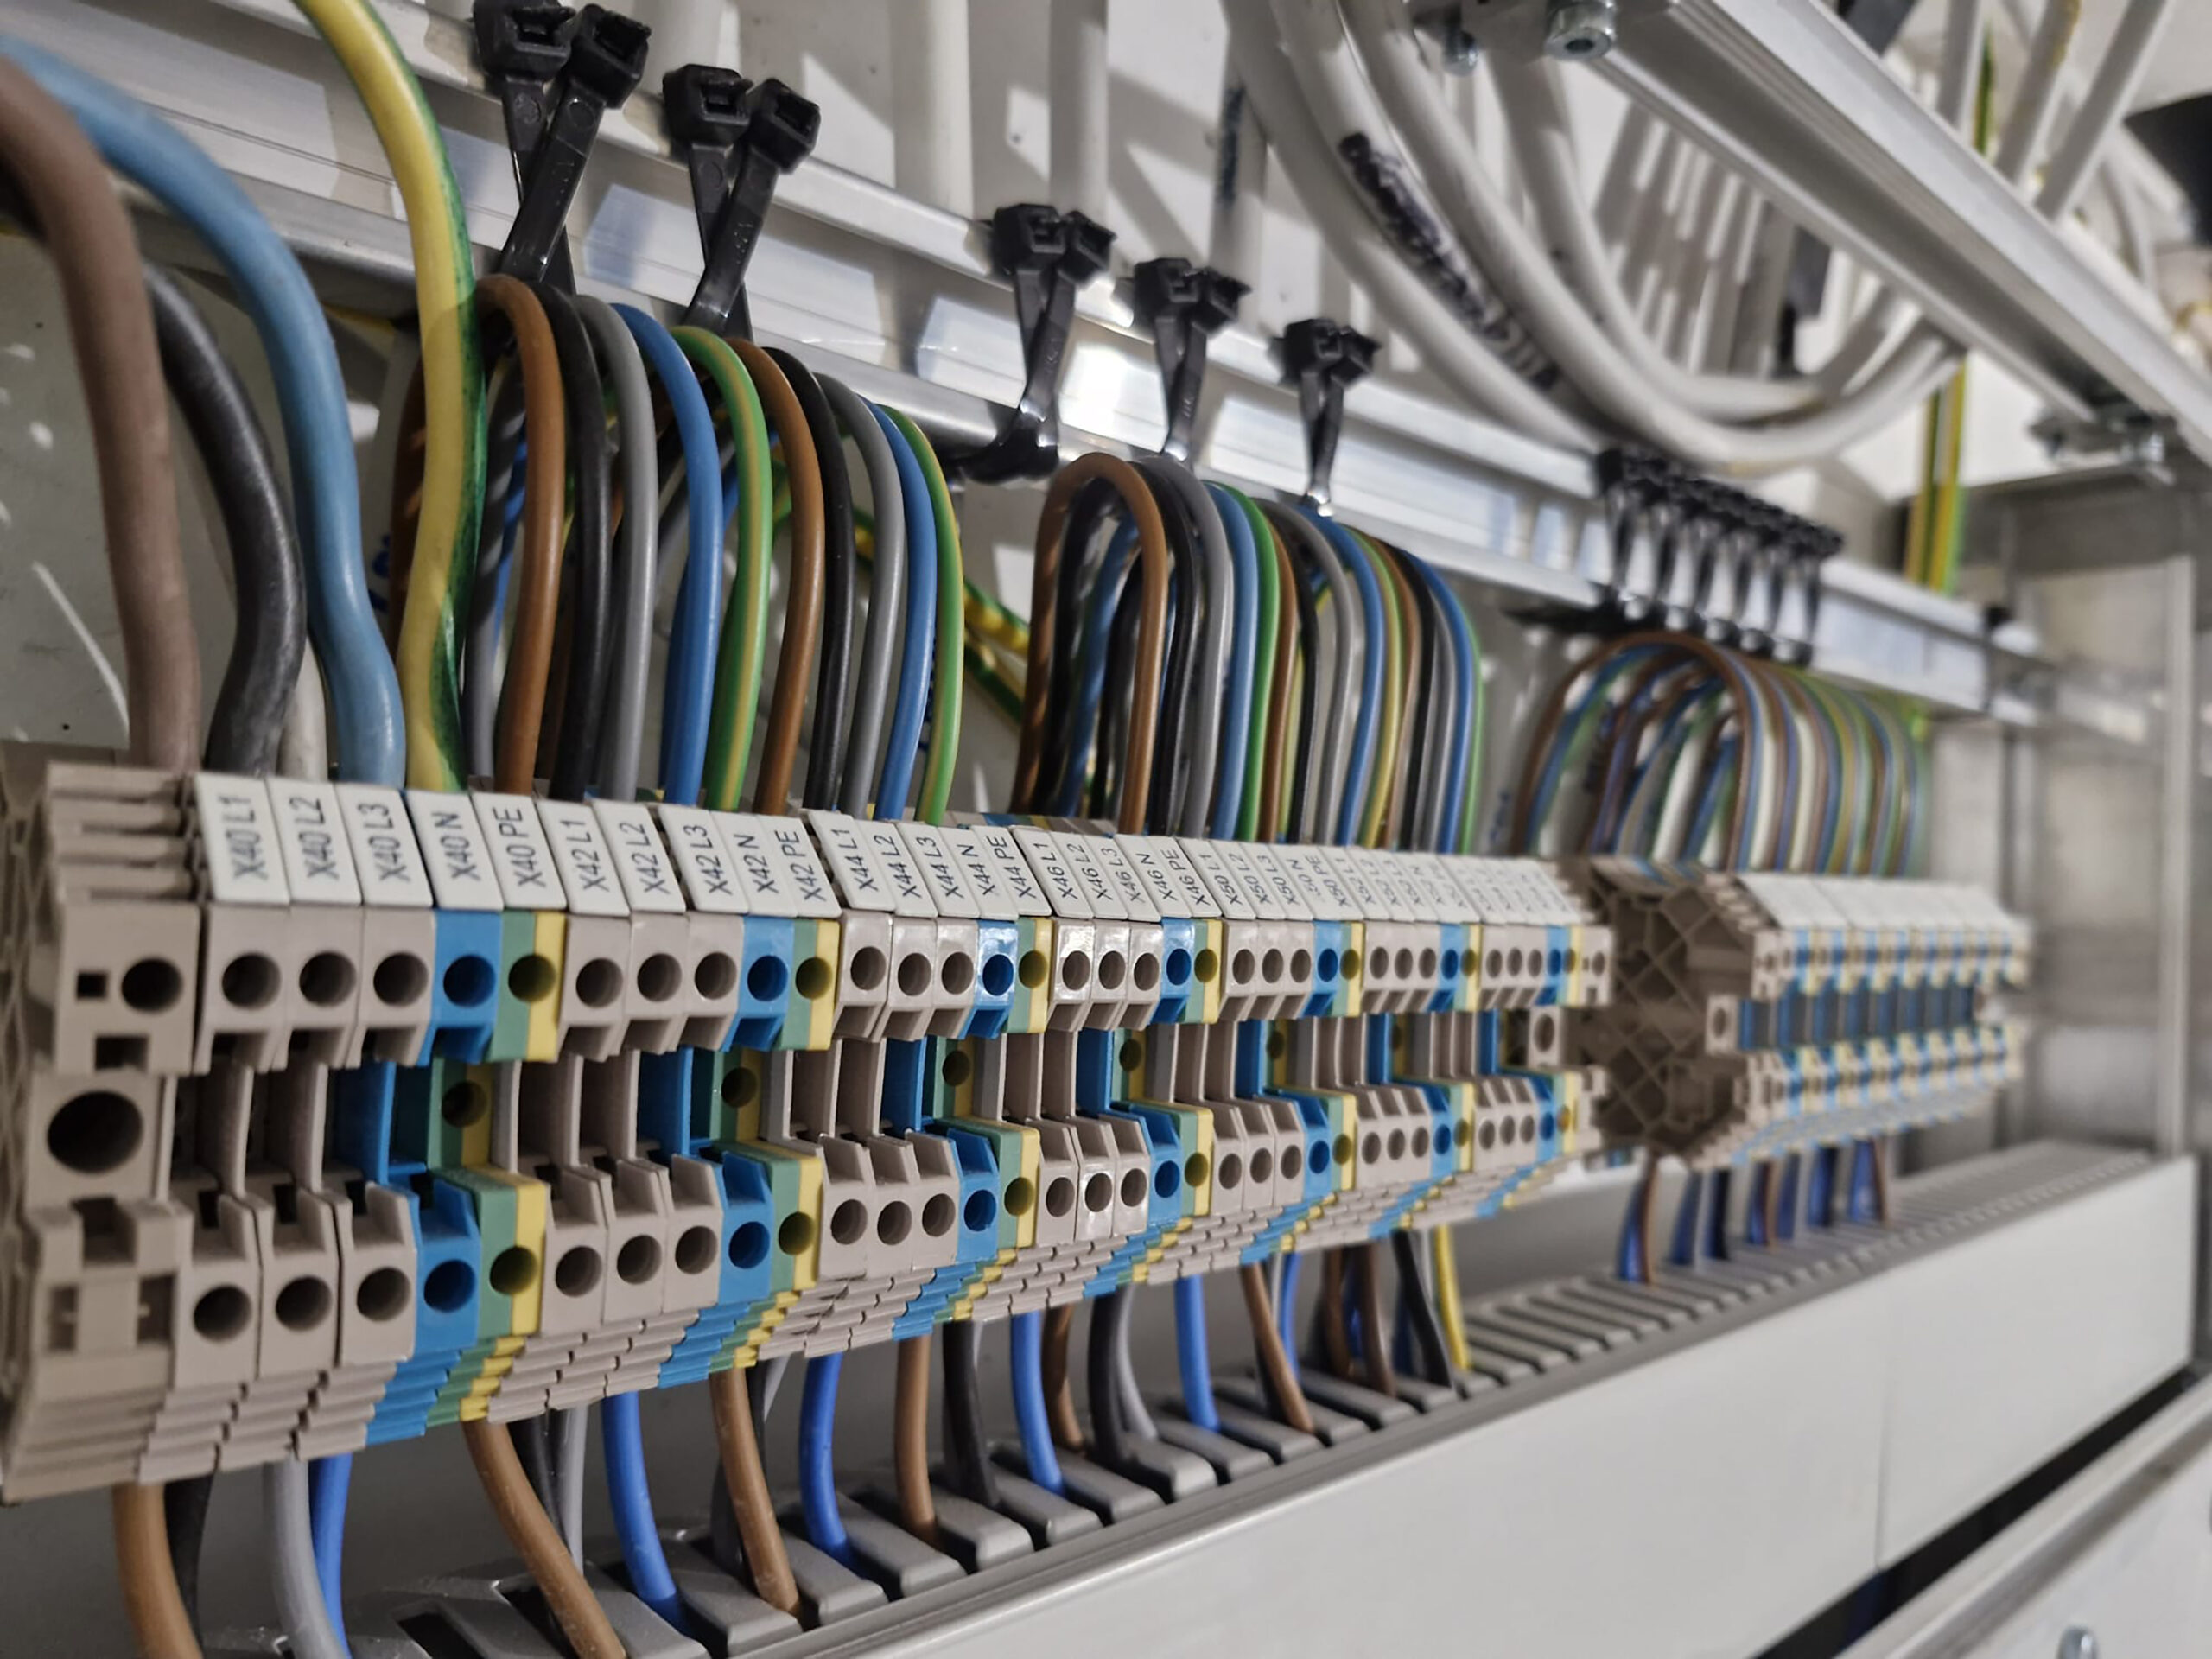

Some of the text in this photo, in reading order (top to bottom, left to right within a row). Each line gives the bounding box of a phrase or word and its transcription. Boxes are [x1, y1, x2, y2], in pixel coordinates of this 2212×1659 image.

[220, 794, 269, 880] X40 L1
[289, 796, 340, 880] X40 L2
[358, 804, 411, 882] X40 L3
[432, 811, 481, 882] X40 N
[493, 808, 546, 888] X40 PE
[562, 819, 610, 892] X42 L1
[620, 823, 671, 895] X42 L2
[683, 826, 733, 895] X42 L3
[734, 834, 779, 893] X42 N
[774, 830, 827, 902] X42 PE
[831, 829, 879, 892] X44 L1
[874, 836, 923, 899] X44 L2
[917, 836, 965, 899] X44 L3
[985, 835, 1037, 899] X44 PE
[957, 845, 996, 896] X44 N
[1033, 842, 1078, 899] X46 L1
[1066, 843, 1113, 900] X46 L2
[1101, 847, 1145, 904] X46 L3
[1135, 853, 1178, 902] X46 N
[1160, 849, 1210, 906] X46 PE
[1199, 854, 1243, 906] X50 L1
[1229, 853, 1273, 905] X50 L2
[1272, 876, 1300, 906] X50
[1287, 859, 1324, 900] 50 N
